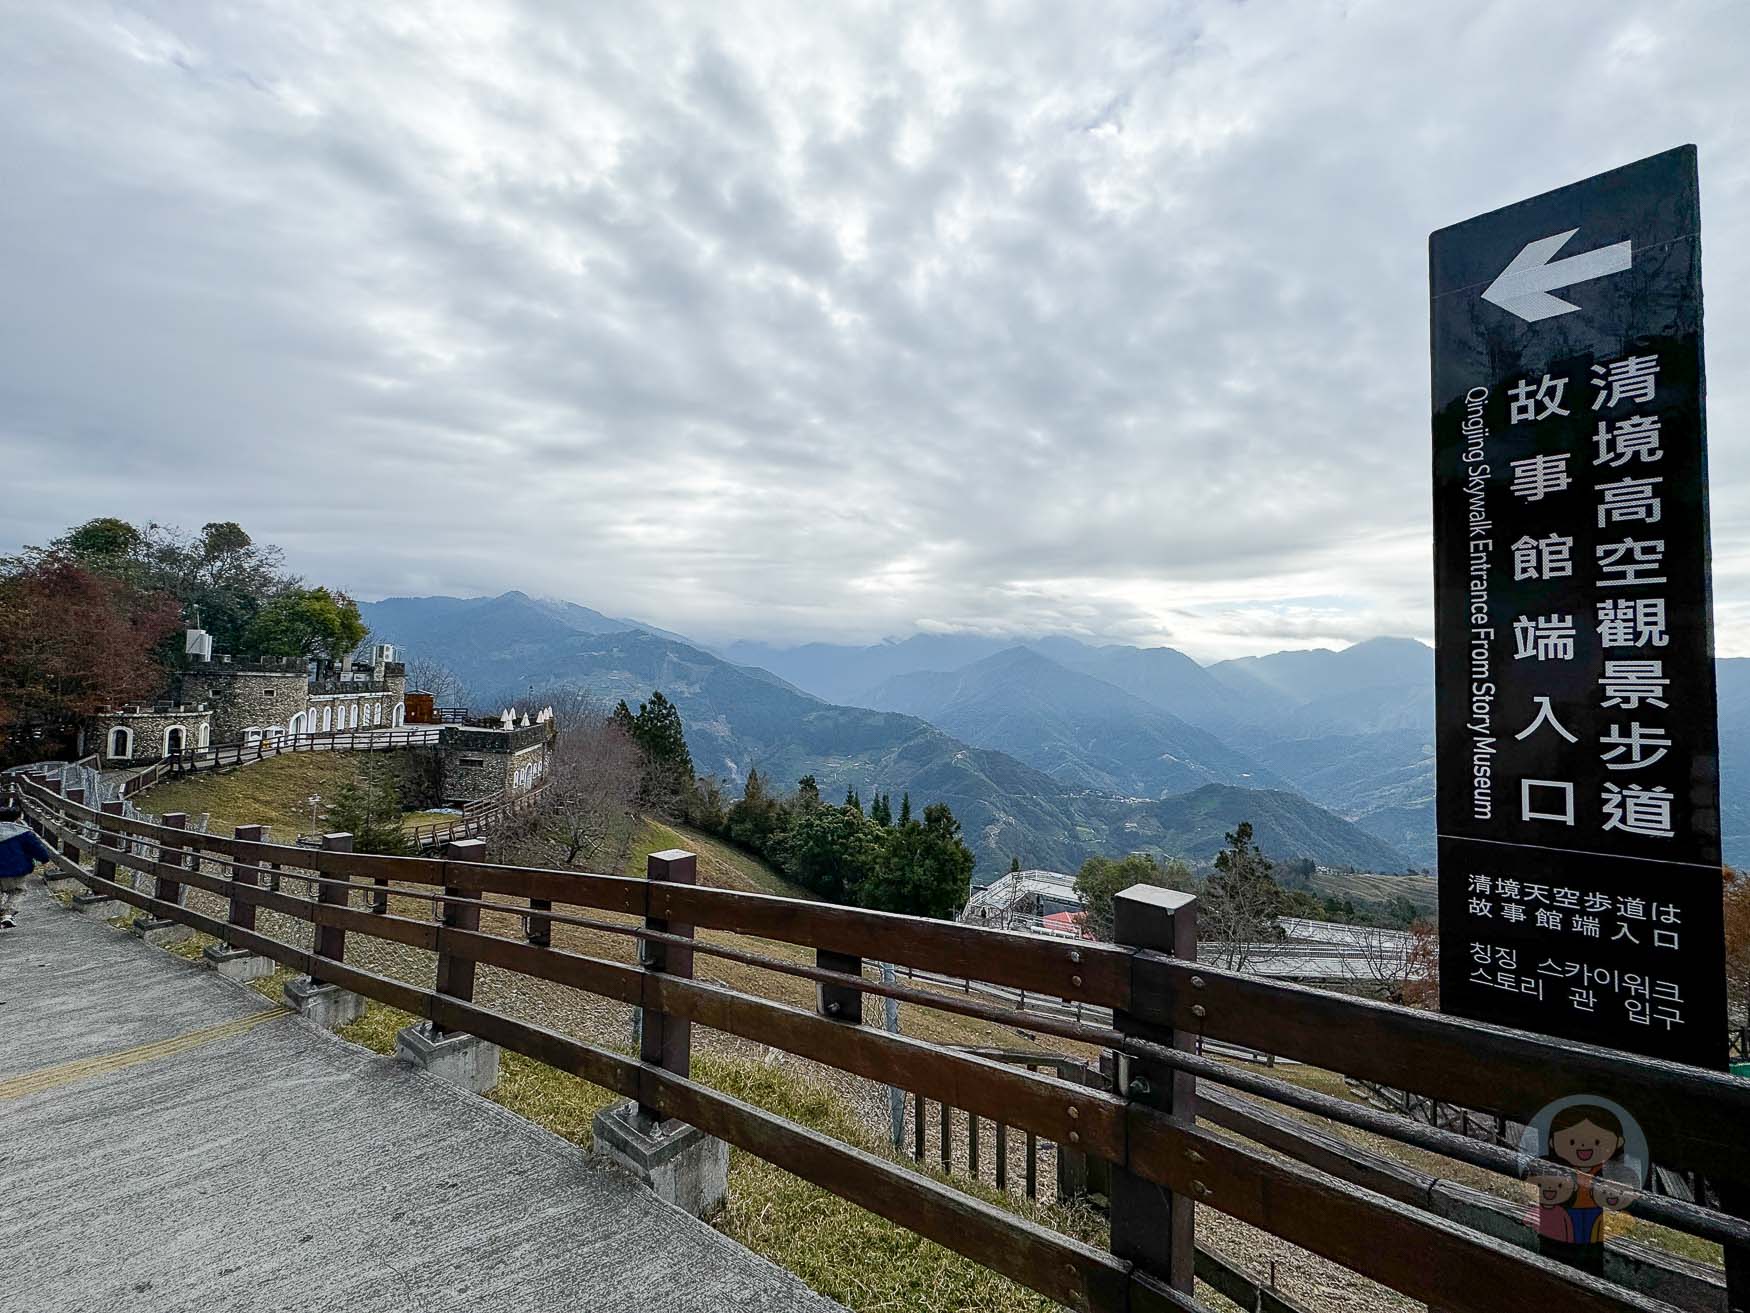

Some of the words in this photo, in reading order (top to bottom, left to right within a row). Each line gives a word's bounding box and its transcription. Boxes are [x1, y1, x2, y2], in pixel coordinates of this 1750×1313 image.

[1462, 386, 1489, 462] Qingjing
[1463, 464, 1492, 536] Skywalk
[1469, 539, 1494, 625] Entrance
[1507, 374, 1579, 826] 故事館端入口
[1590, 353, 1675, 838] 清境高空觀景步道
[1471, 628, 1495, 679] From
[1467, 682, 1496, 734] Story
[1473, 737, 1497, 820] Museum
[1467, 897, 1680, 951] 故事館端入口
[1469, 941, 1518, 970] 칭징
[1536, 957, 1685, 1004] 스카이워크
[1469, 967, 1544, 1001] 스토리
[1624, 1000, 1686, 1031] 입구
